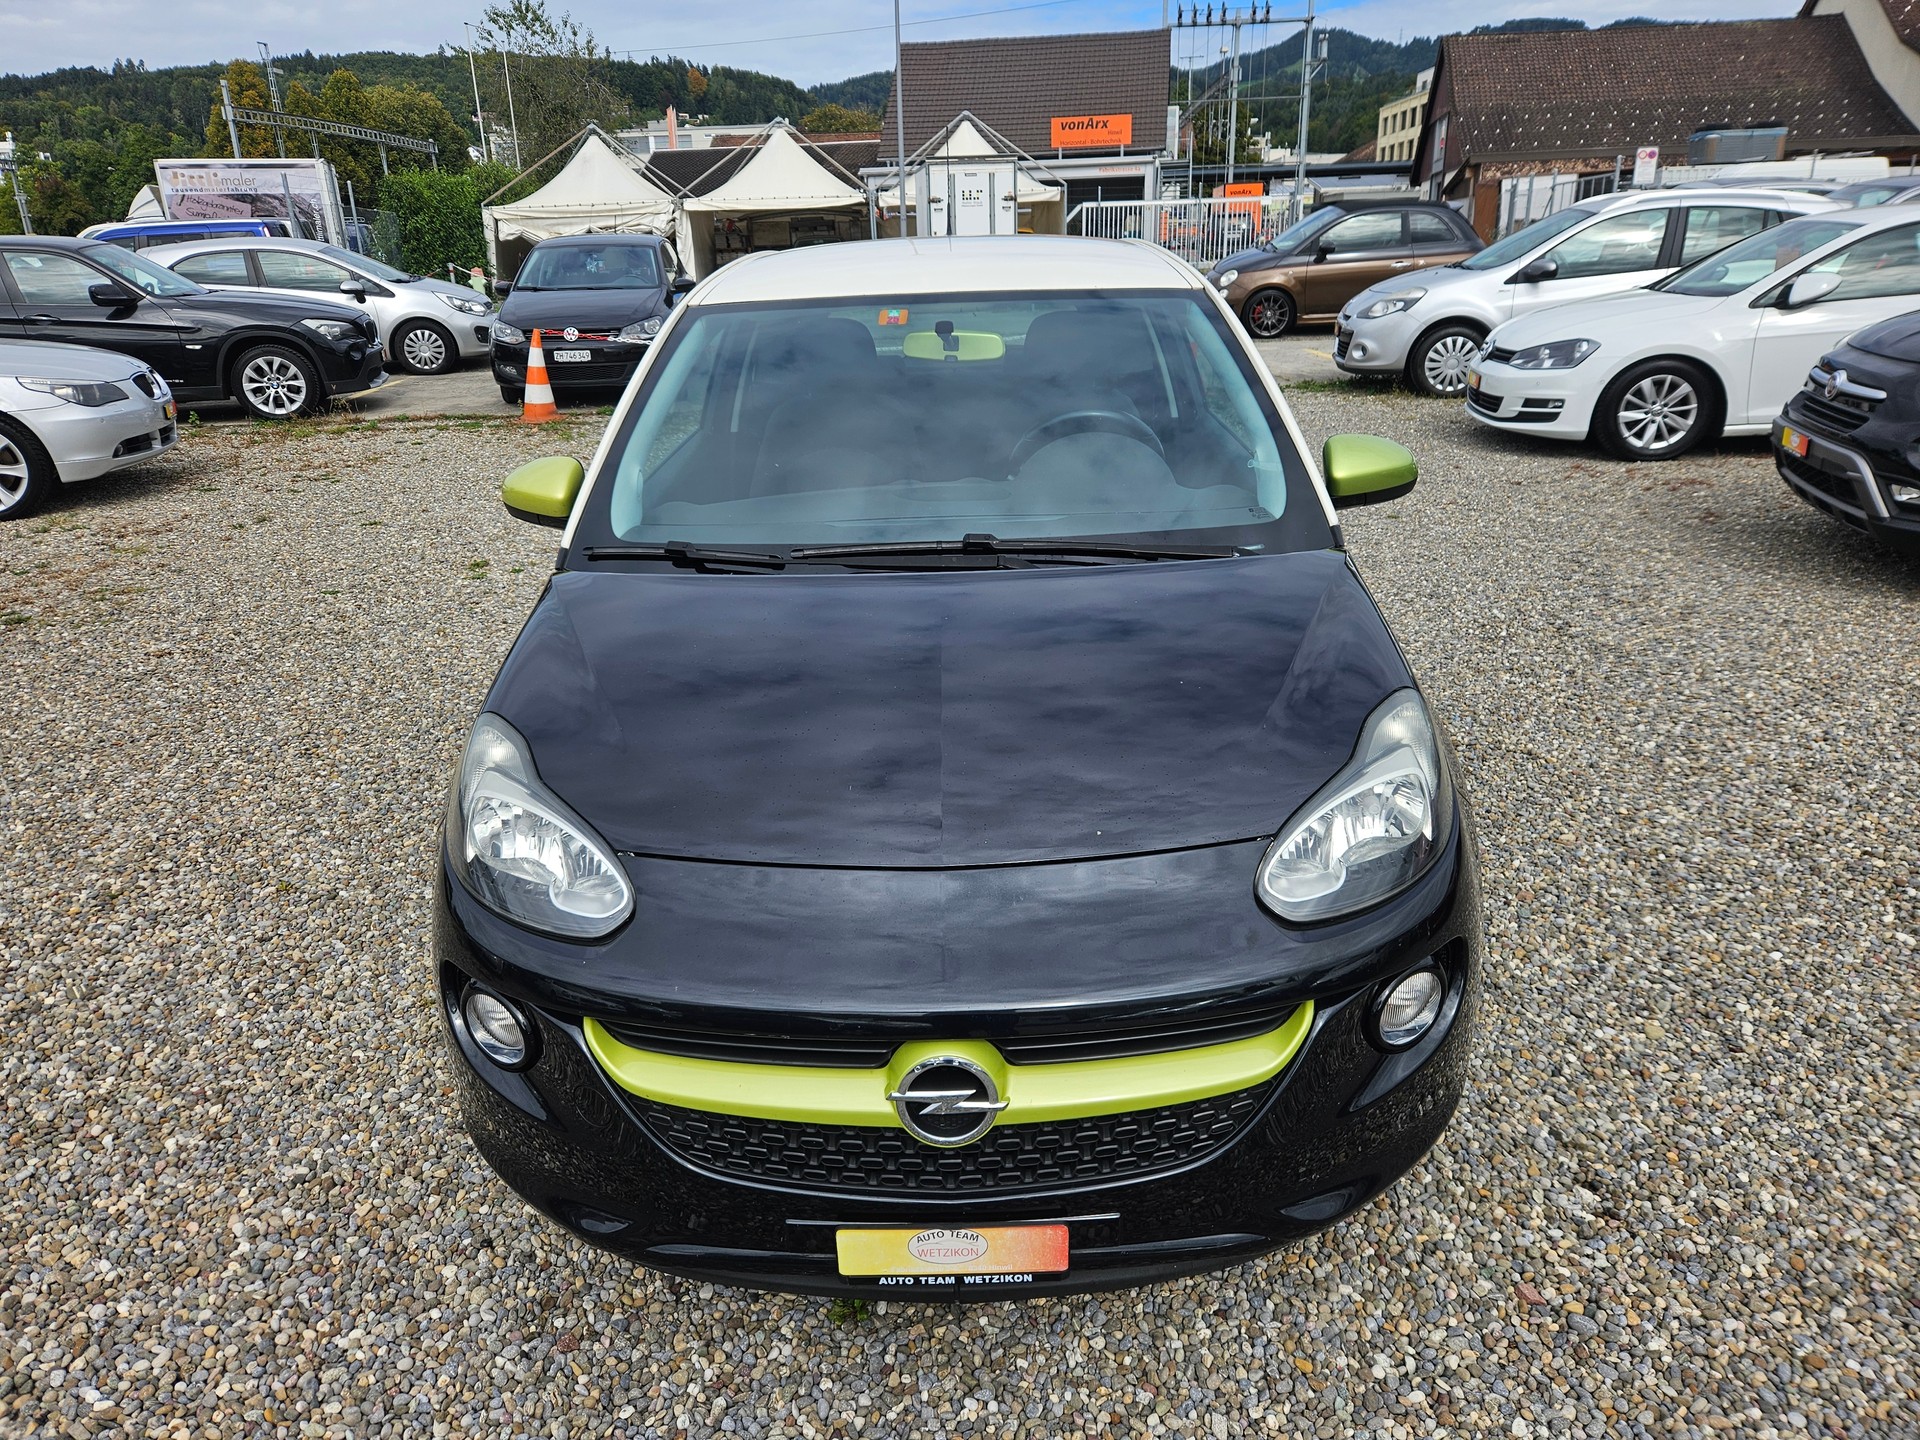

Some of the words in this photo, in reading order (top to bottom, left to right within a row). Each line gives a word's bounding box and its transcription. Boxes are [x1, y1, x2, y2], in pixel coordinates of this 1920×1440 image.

[1061, 117, 1109, 131] vonArx
[916, 1230, 945, 1244] AUTO
[949, 1230, 980, 1243] TEAM
[917, 1247, 979, 1258] WETZIKON
[878, 1276, 914, 1285] AUTO
[919, 1276, 956, 1285] TEAM
[963, 1273, 1033, 1285] WETZIKON
